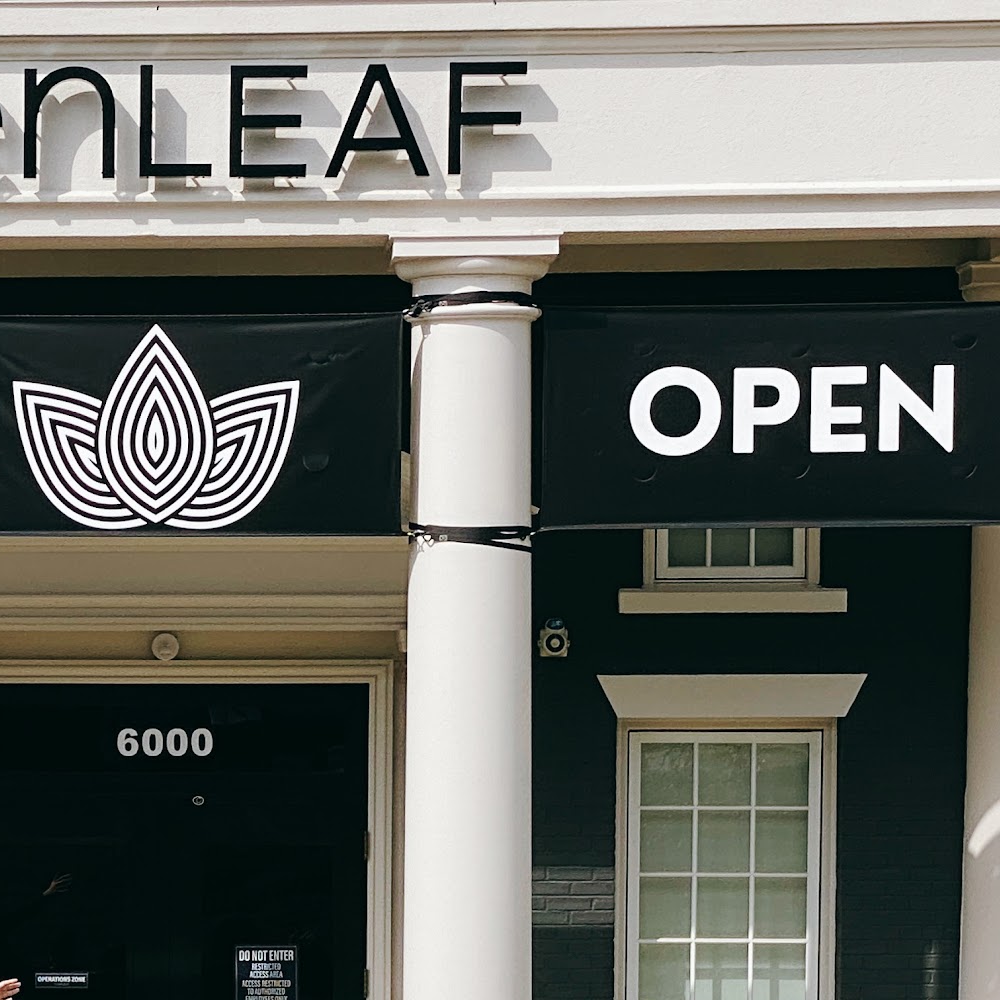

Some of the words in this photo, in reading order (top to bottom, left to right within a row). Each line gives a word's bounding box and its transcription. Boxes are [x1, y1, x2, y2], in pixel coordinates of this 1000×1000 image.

[629, 363, 955, 456] OPEN
[117, 728, 213, 757] 6000
[239, 950, 250, 961] DO
[252, 950, 268, 961] NOT
[269, 950, 294, 961] ENTER
[251, 962, 281, 970] RESTRICTED
[249, 970, 269, 978] ACCESS
